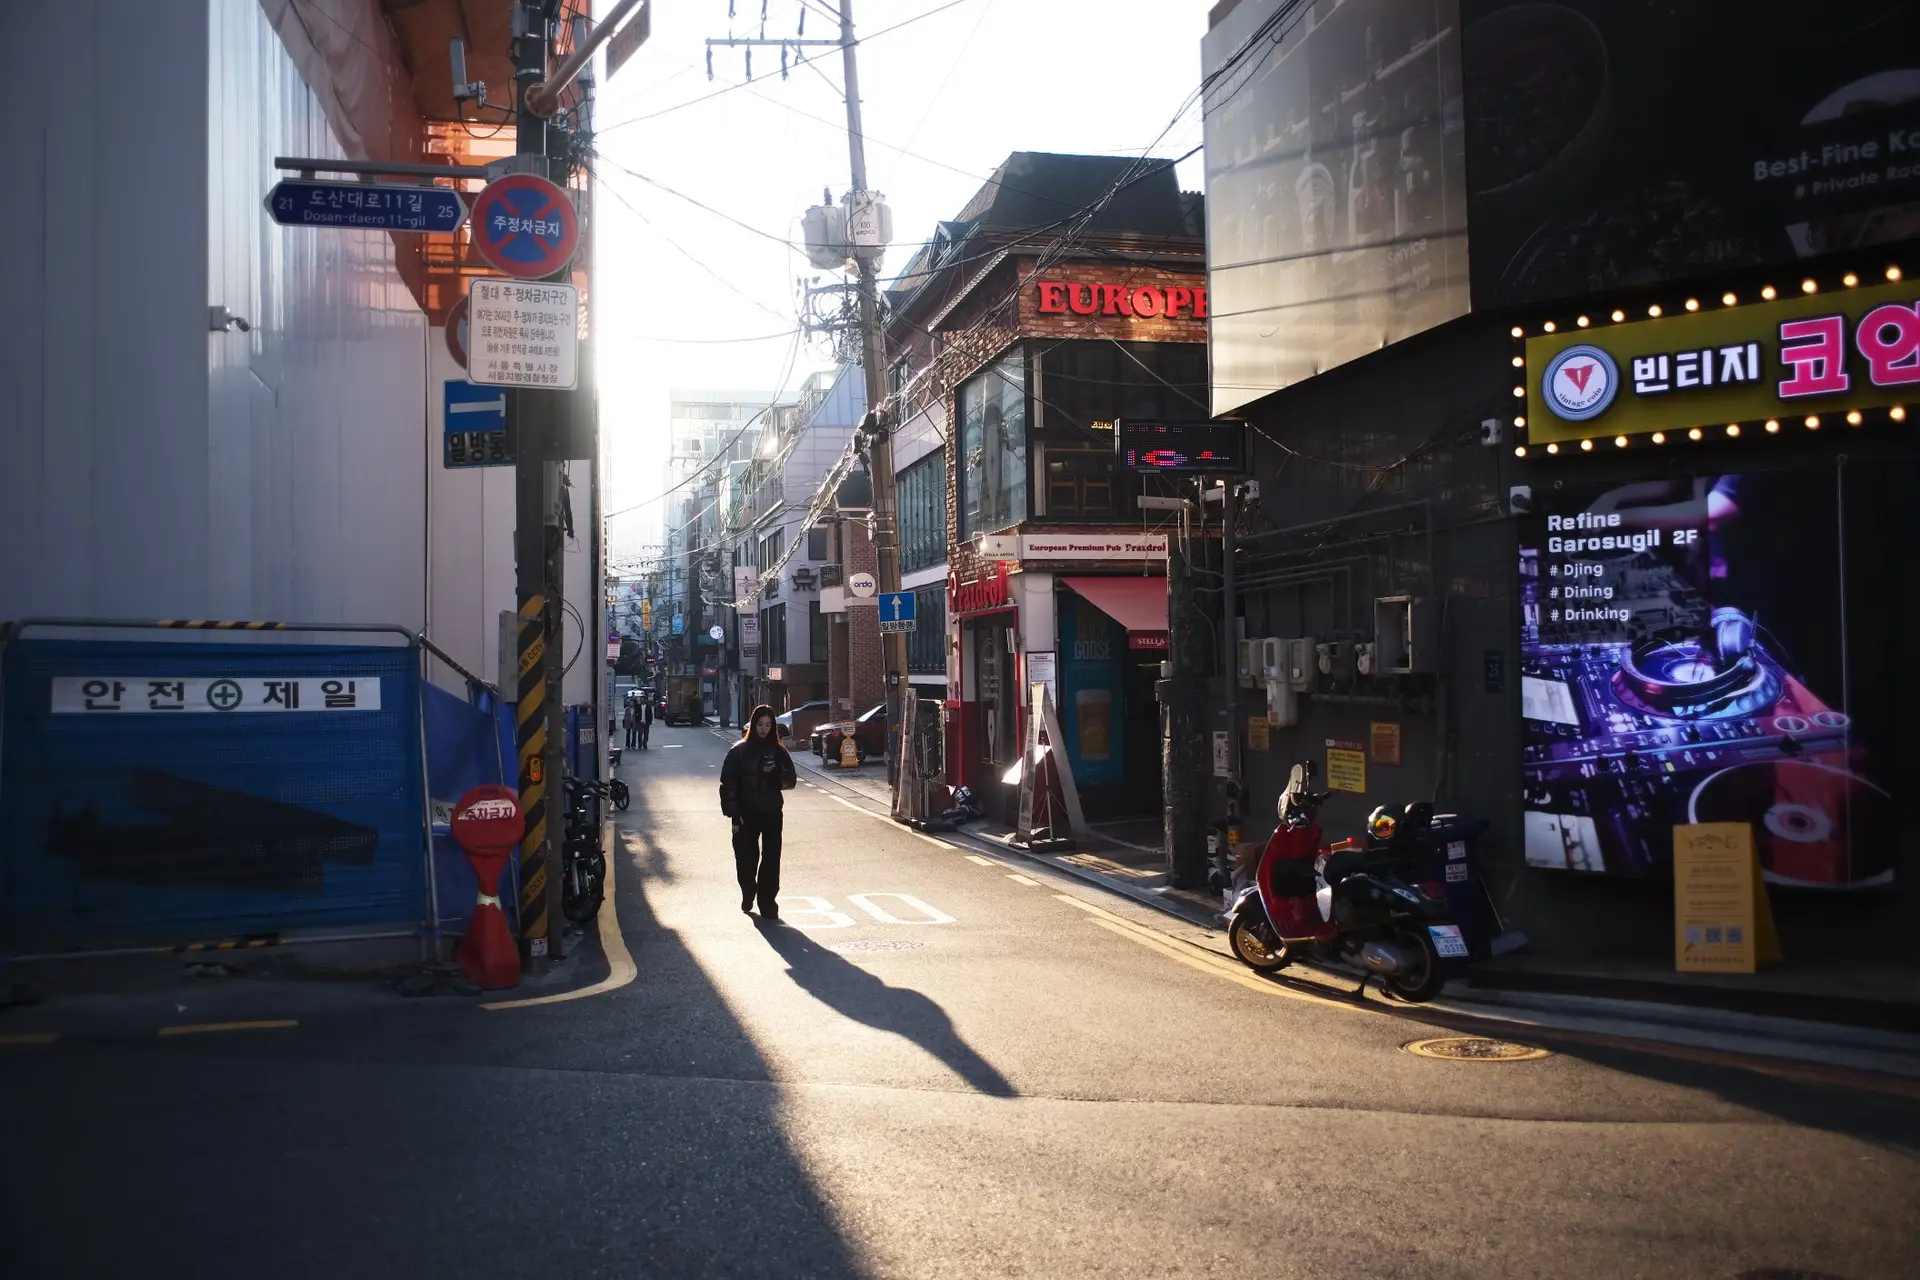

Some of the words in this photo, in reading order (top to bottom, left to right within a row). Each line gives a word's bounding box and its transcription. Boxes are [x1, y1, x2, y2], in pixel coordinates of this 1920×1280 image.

[1753, 140, 1879, 182] Best-Fine
[1812, 171, 1879, 196] Private
[279, 197, 293, 211] 21
[309, 189, 423, 212] 도산대로11길
[438, 205, 454, 219] 25
[303, 209, 386, 225] Dosan-daero
[390, 214, 426, 228] 11-gil
[494, 215, 559, 237] 주정차금지
[480, 285, 499, 301] 절대
[1634, 343, 1758, 394] 빈티지
[1558, 393, 1586, 407] vintage
[1586, 387, 1602, 403] coin
[449, 431, 506, 463] 일방통
[1547, 512, 1621, 532] Refine
[1029, 544, 1068, 553] European
[1068, 544, 1105, 552] Premium
[1106, 544, 1122, 552] Pub
[1548, 529, 1661, 553] Garosugil
[1673, 529, 1698, 546] 2F
[1564, 562, 1603, 579] Djing
[1564, 584, 1614, 602] Dining
[1564, 607, 1630, 623] Drinking
[1137, 637, 1166, 646] STELLA
